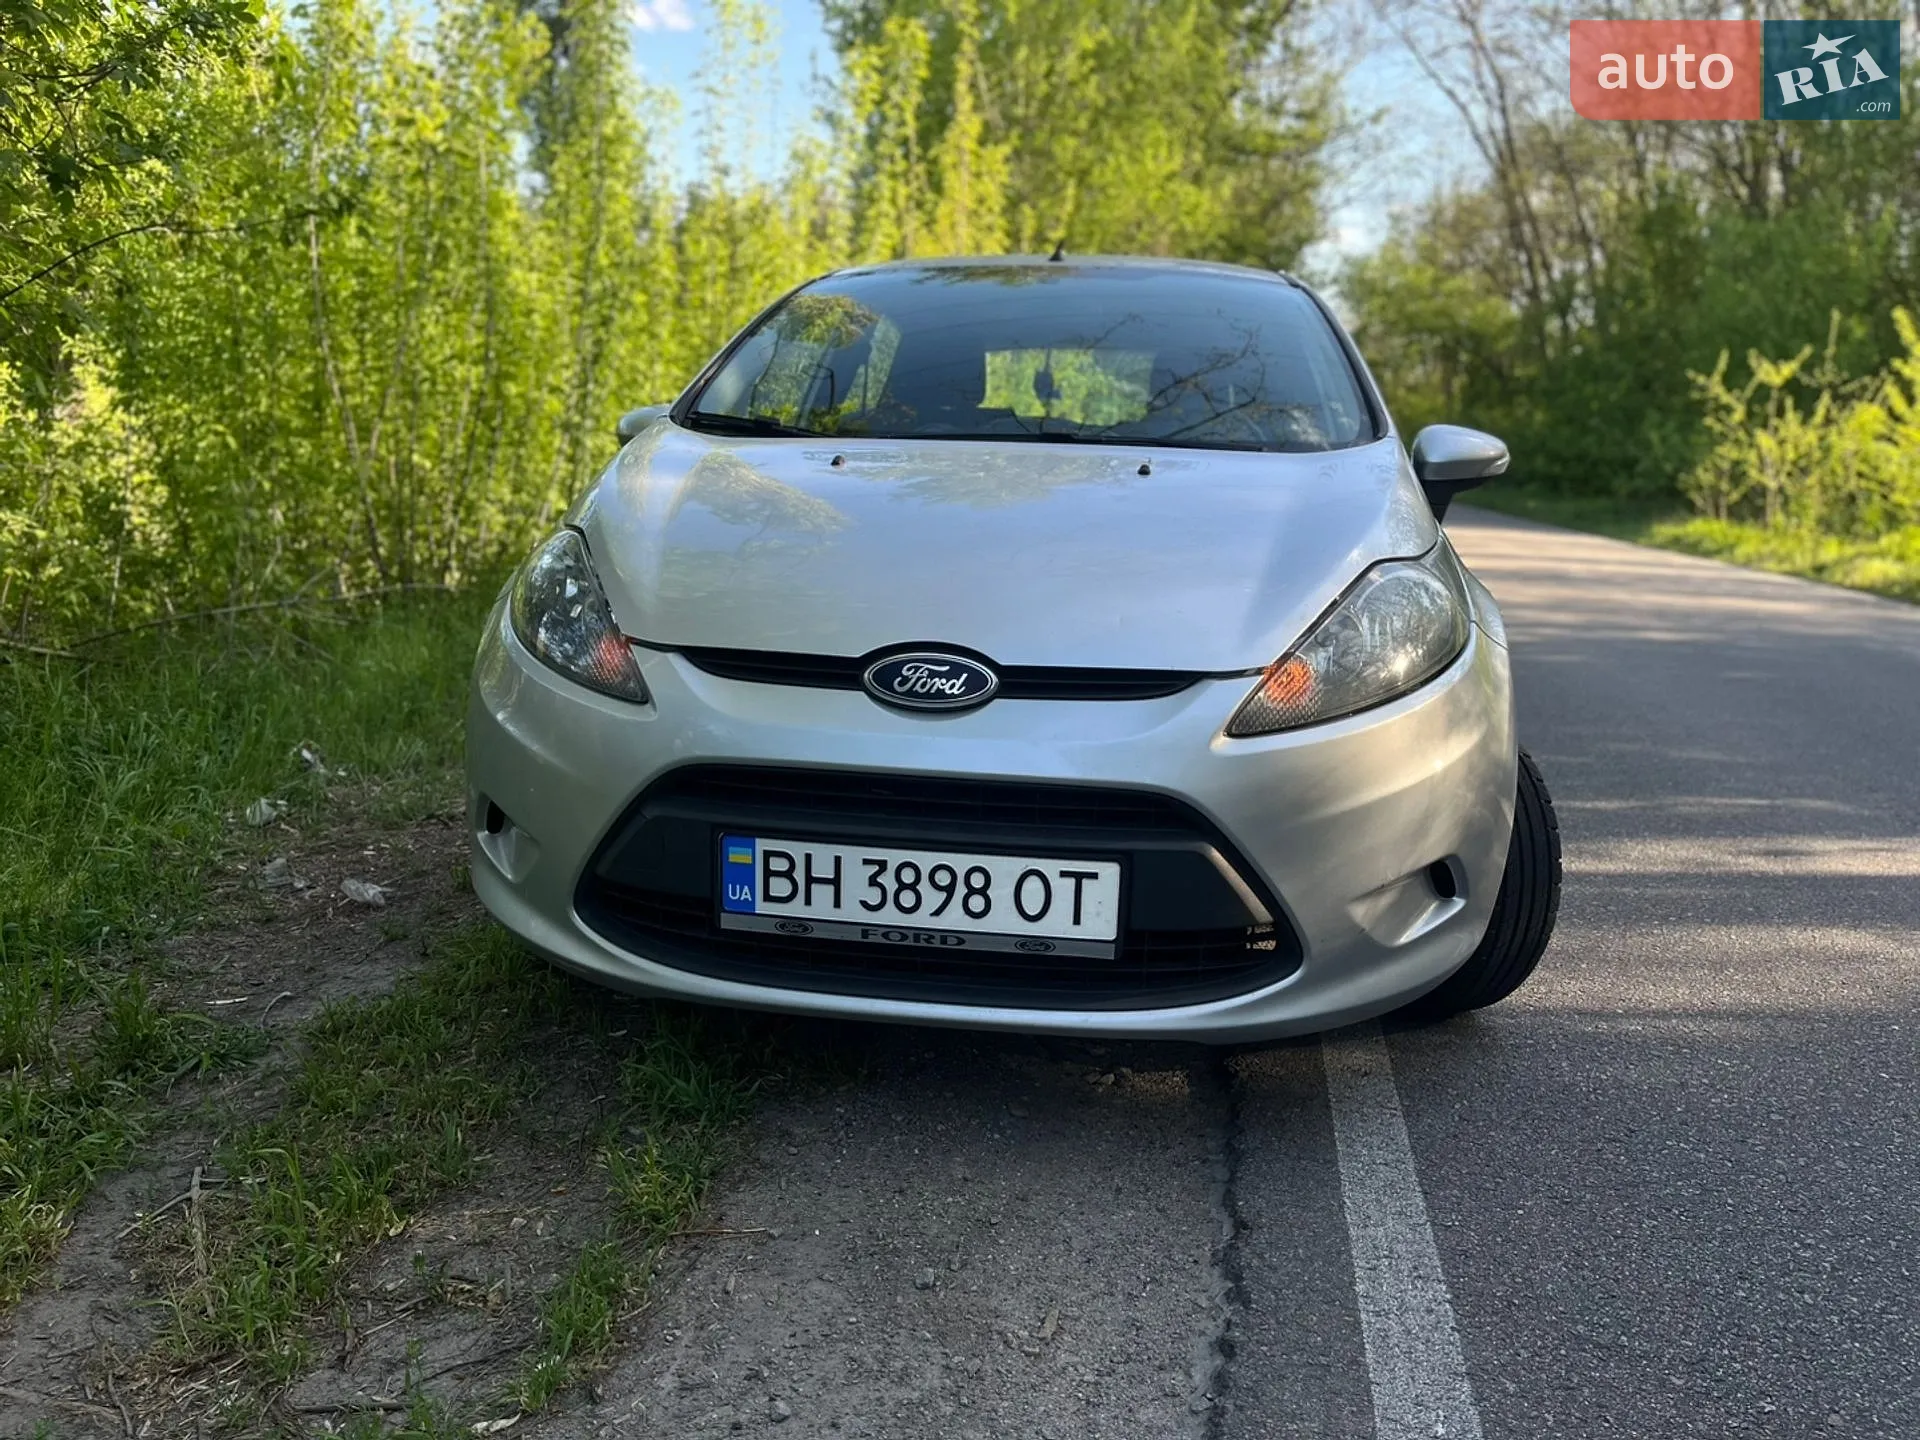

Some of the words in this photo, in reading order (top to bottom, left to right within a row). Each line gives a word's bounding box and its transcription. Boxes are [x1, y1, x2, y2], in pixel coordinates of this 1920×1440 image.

[893, 662, 968, 694] Ford
[728, 883, 752, 902] UA
[762, 849, 842, 909] BH
[859, 858, 992, 919] 3898
[1014, 868, 1099, 926] OT
[861, 928, 967, 948] FORD
